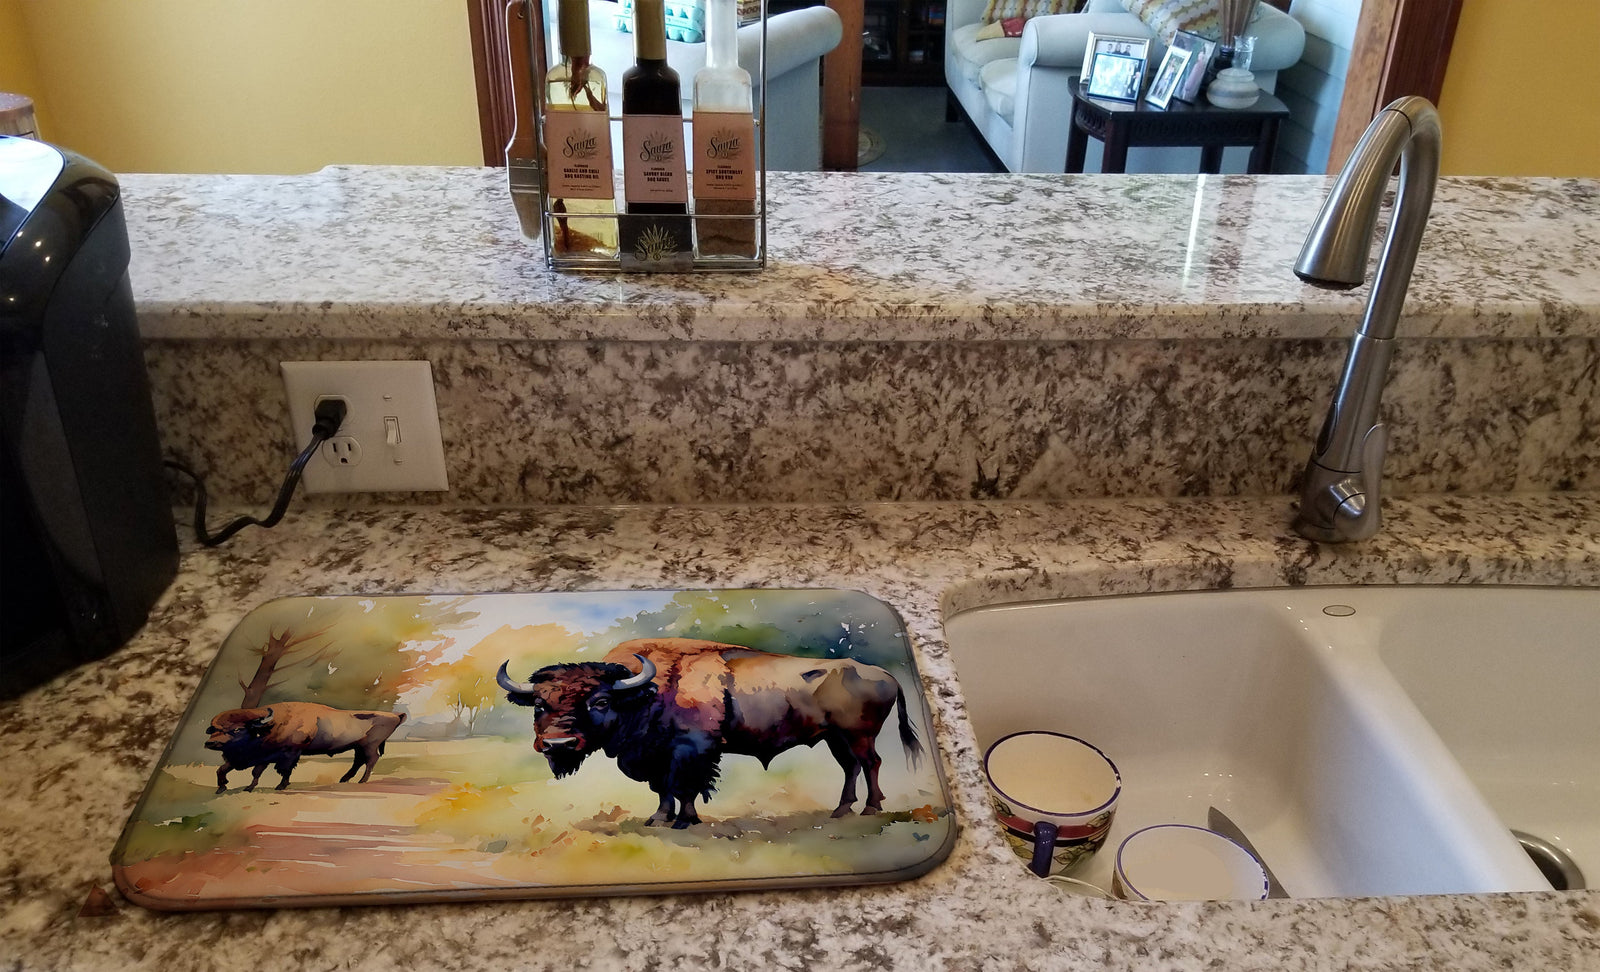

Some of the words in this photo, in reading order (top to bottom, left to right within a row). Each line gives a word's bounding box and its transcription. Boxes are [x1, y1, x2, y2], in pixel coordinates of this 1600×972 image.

[562, 136, 598, 158] Sauza
[640, 140, 674, 162] Sauza
[706, 136, 740, 159] Sauza
